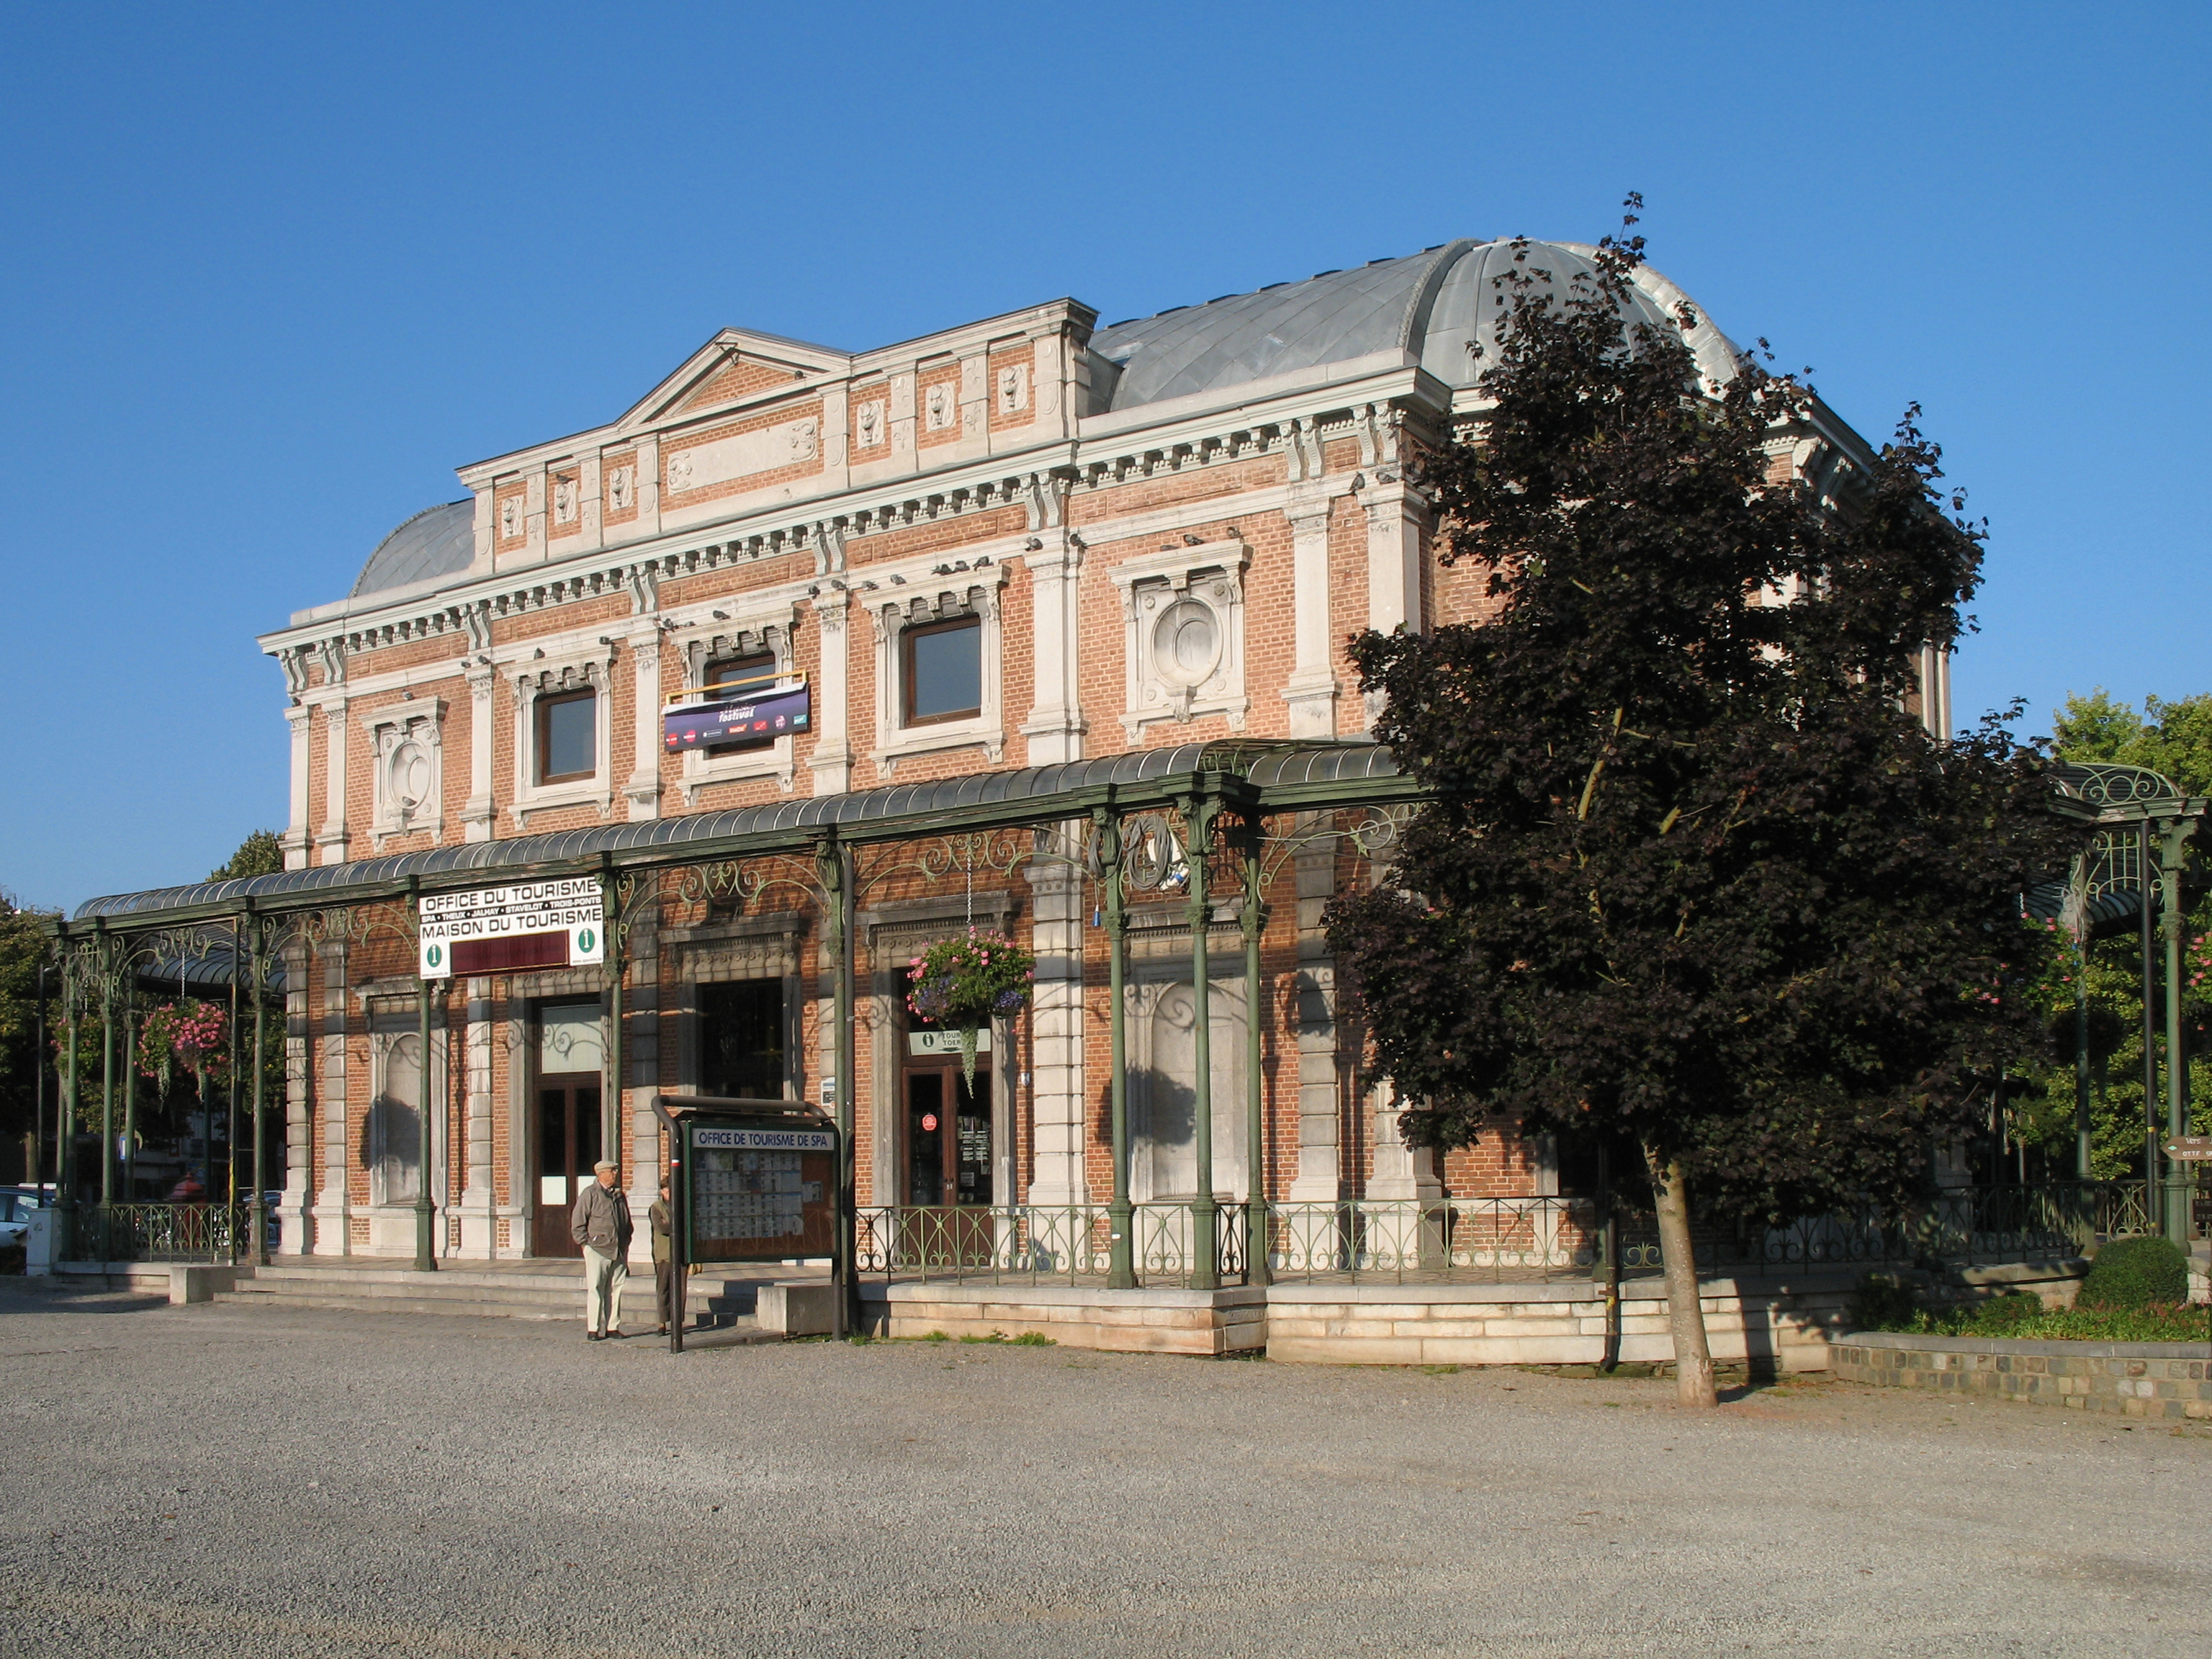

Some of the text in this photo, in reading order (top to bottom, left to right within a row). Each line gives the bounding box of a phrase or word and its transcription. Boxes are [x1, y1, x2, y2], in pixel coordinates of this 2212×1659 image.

[719, 706, 757, 723] festival
[426, 879, 597, 912] OFFICE DU TOURISME
[471, 907, 500, 917] JALHAY
[505, 903, 543, 914] STAVELOT
[549, 896, 601, 908] TROIS-PONTS
[422, 908, 602, 939] MAISON DU TOURISME
[699, 1132, 827, 1146] OFFICE DE TOURISME DE SPA
